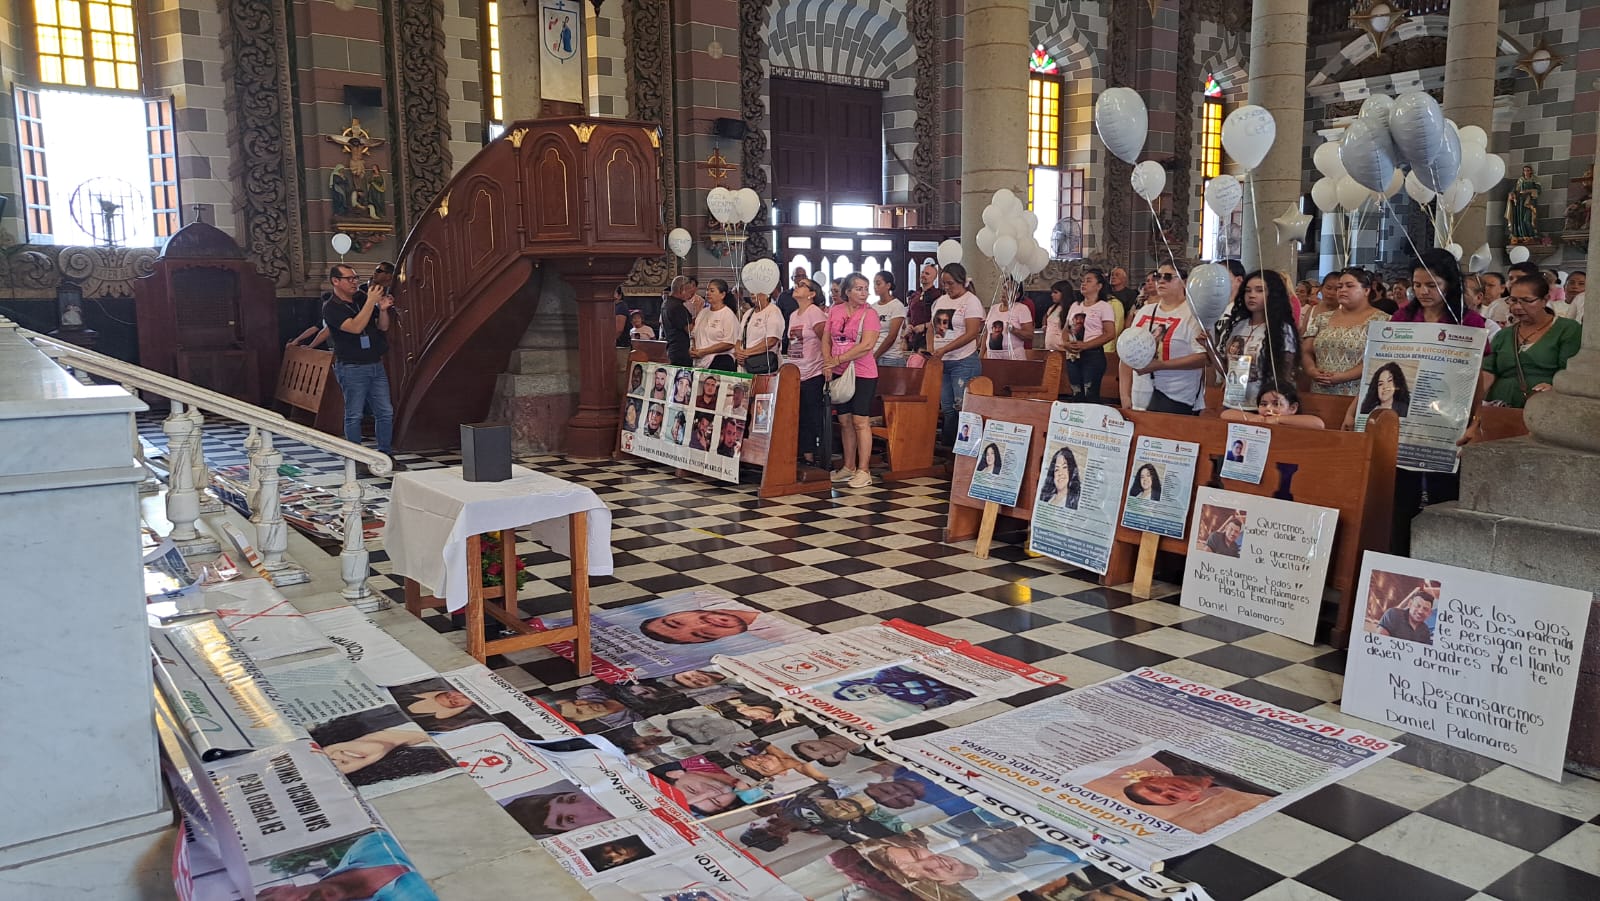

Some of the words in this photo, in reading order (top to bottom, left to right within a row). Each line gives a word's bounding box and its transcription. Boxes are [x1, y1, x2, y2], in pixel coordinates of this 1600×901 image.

[770, 66, 791, 78] EMPLO
[1257, 517, 1305, 534] Queremos
[1201, 561, 1215, 573] No
[1220, 568, 1258, 583] estamos
[1219, 584, 1246, 600] Hasta
[1199, 596, 1228, 613] Daniel
[1238, 605, 1285, 626] Palomares
[1438, 610, 1455, 624] de
[1460, 615, 1480, 630] los
[1448, 598, 1483, 618] Que
[1492, 605, 1516, 625] los
[1534, 619, 1571, 637] ojos
[1366, 646, 1402, 662] dejen
[1438, 624, 1452, 638] te
[1459, 628, 1523, 654] persigan
[1528, 645, 1548, 657] en
[1554, 650, 1572, 666] tus
[1364, 632, 1382, 646] de
[1390, 639, 1414, 654] sus
[1423, 646, 1482, 671] madres
[1491, 663, 1509, 676] no
[1532, 671, 1548, 686] te
[1510, 652, 1524, 669] el
[1528, 656, 1564, 678] llanto
[1215, 693, 1252, 708] 669
[1389, 672, 1411, 691] No
[1422, 681, 1545, 728] Descansaremos
[1393, 686, 1438, 711] Hasta
[1446, 702, 1530, 737] Encontrarte
[1347, 734, 1390, 752] 669
[1386, 708, 1436, 732] Daniel
[1446, 723, 1519, 755] Palomares
[961, 739, 1006, 761] GUERRA
[1005, 756, 1061, 784] VELARDE
[245, 793, 280, 822] PUEBLO
[1060, 780, 1137, 823] SALVADOR
[261, 820, 287, 836] EN
[303, 813, 332, 832] SAN
